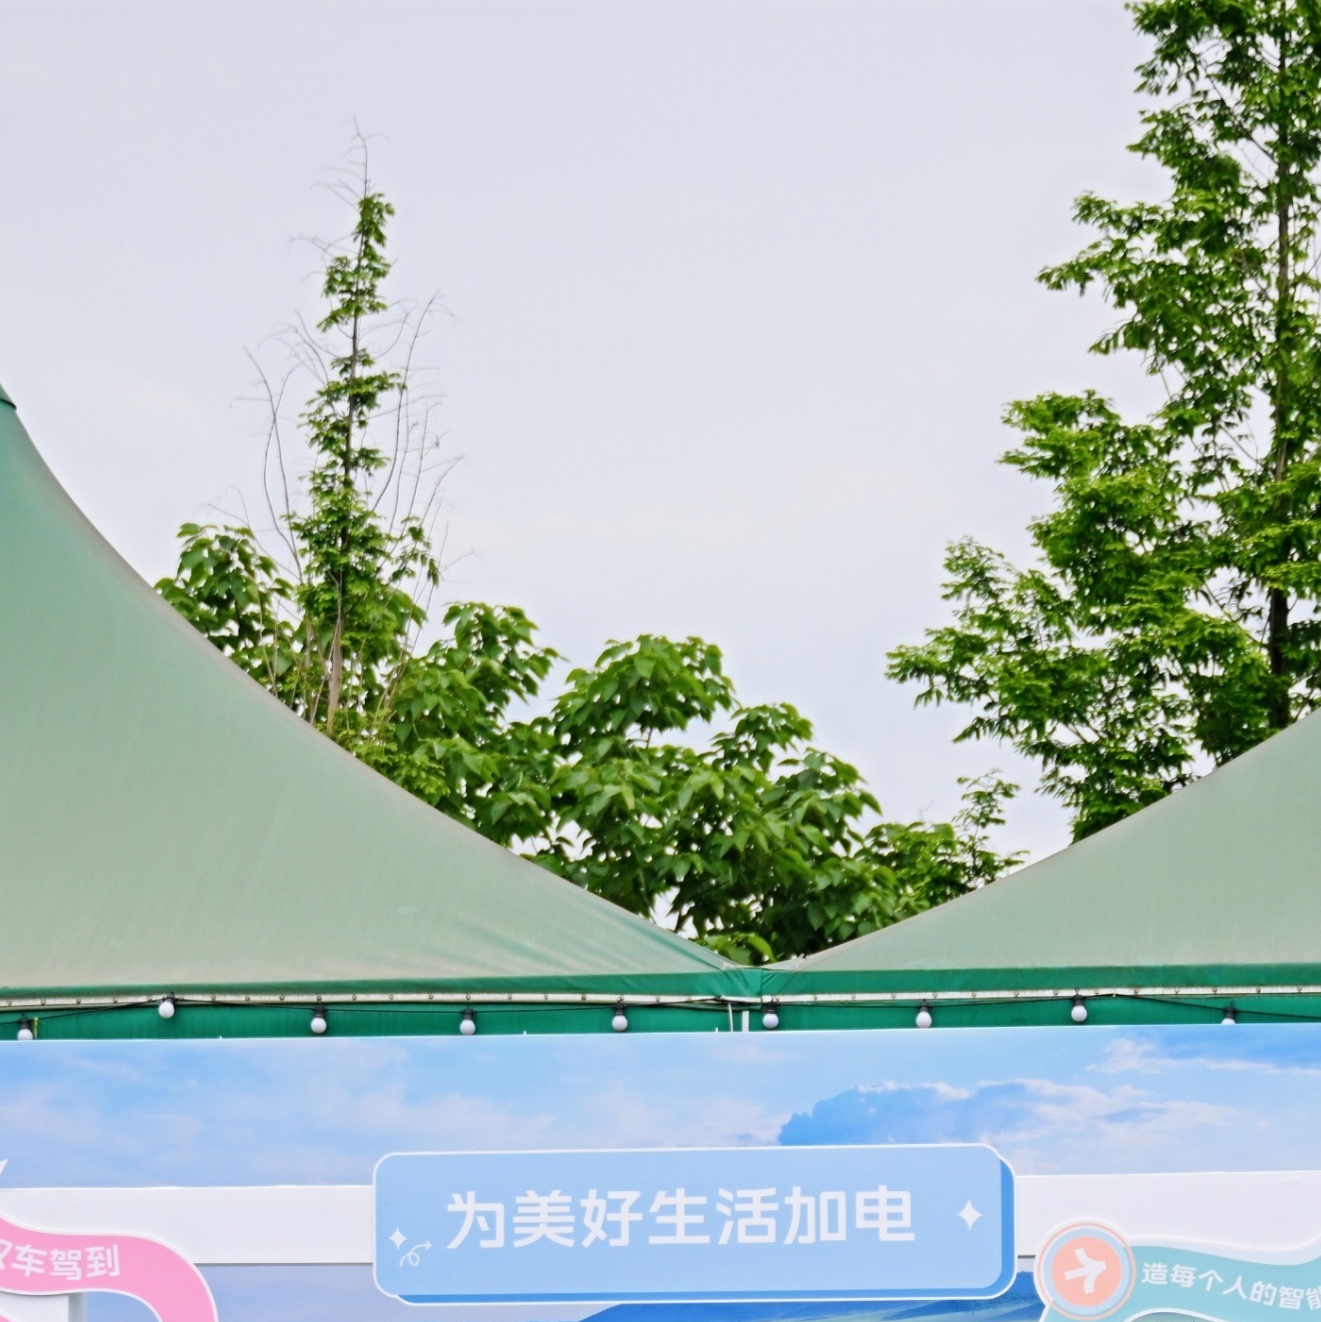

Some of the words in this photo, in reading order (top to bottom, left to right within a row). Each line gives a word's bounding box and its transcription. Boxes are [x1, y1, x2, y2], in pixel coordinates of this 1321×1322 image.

[445, 1185, 916, 1250] 为美好生活加电
